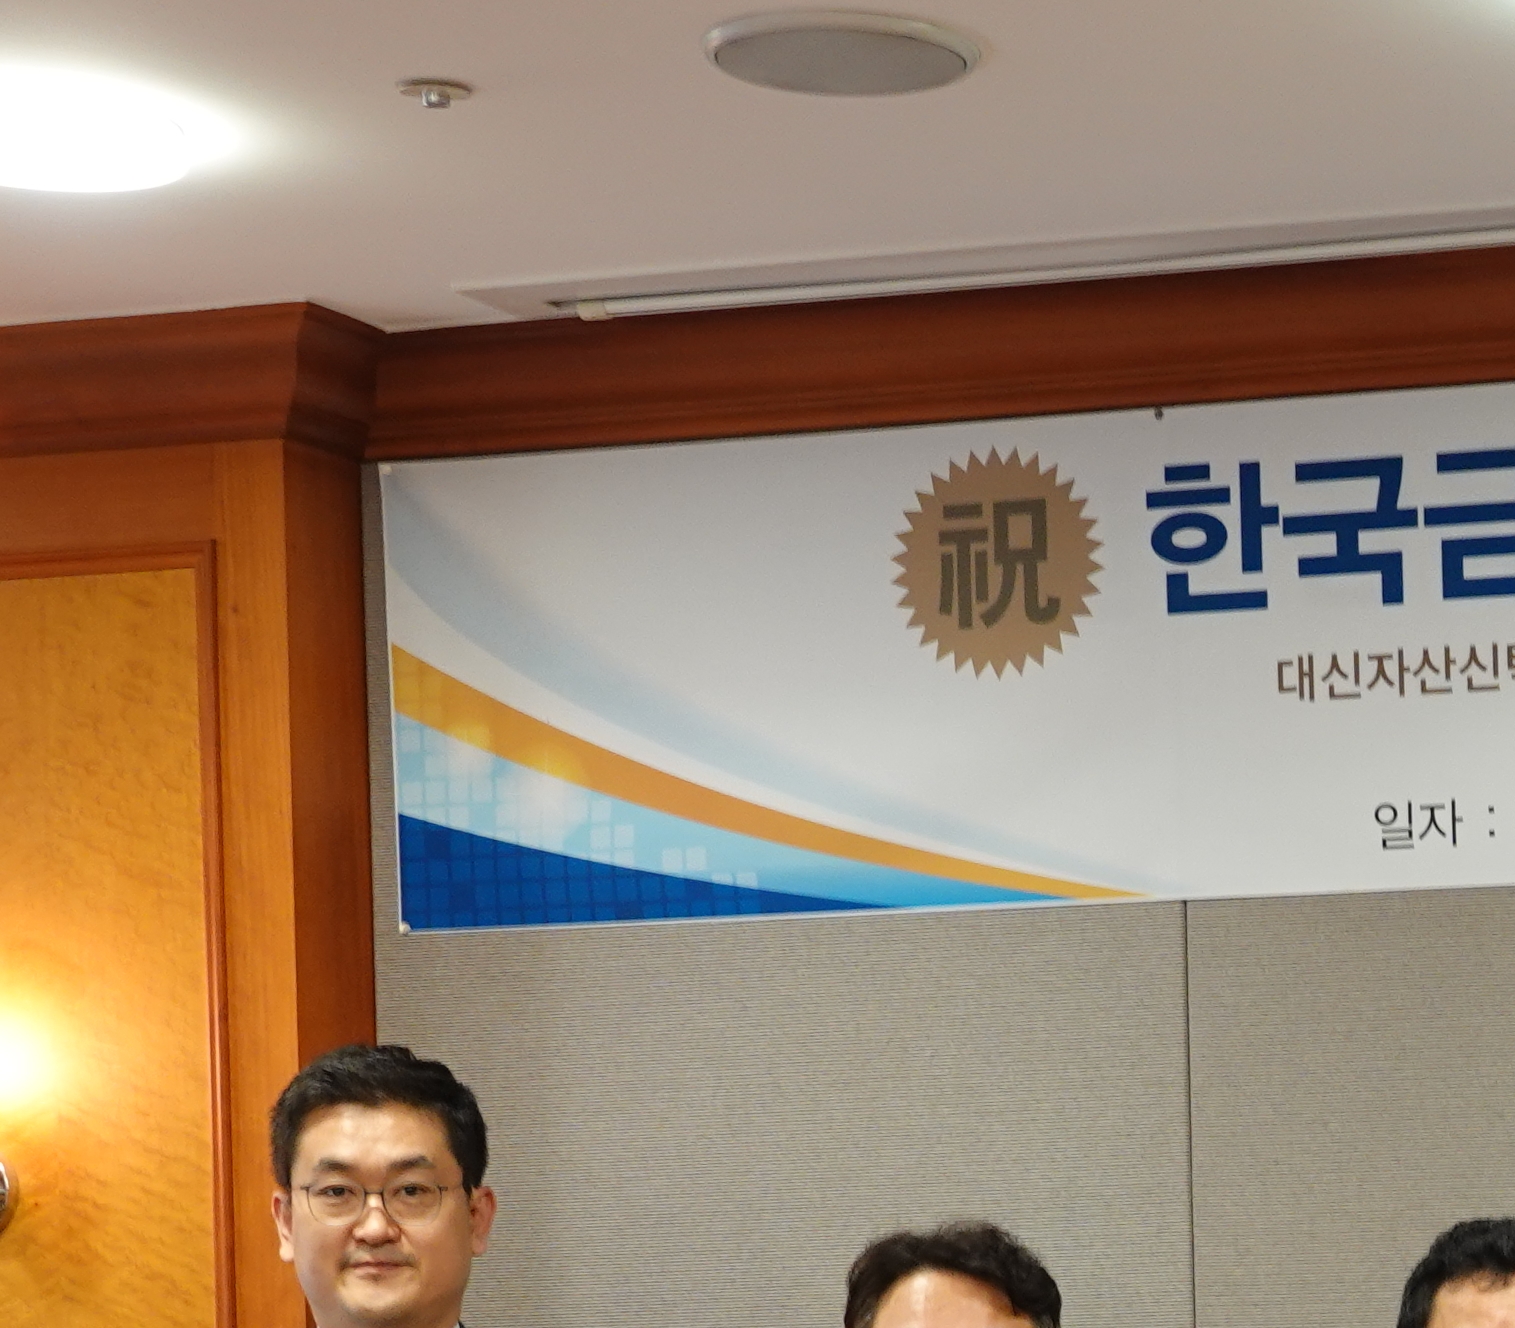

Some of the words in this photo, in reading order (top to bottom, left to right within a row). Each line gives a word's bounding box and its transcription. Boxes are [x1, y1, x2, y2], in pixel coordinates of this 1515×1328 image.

[938, 497, 1061, 630] 祝
[1373, 798, 1463, 851] 일자
[1486, 805, 1497, 839] :
